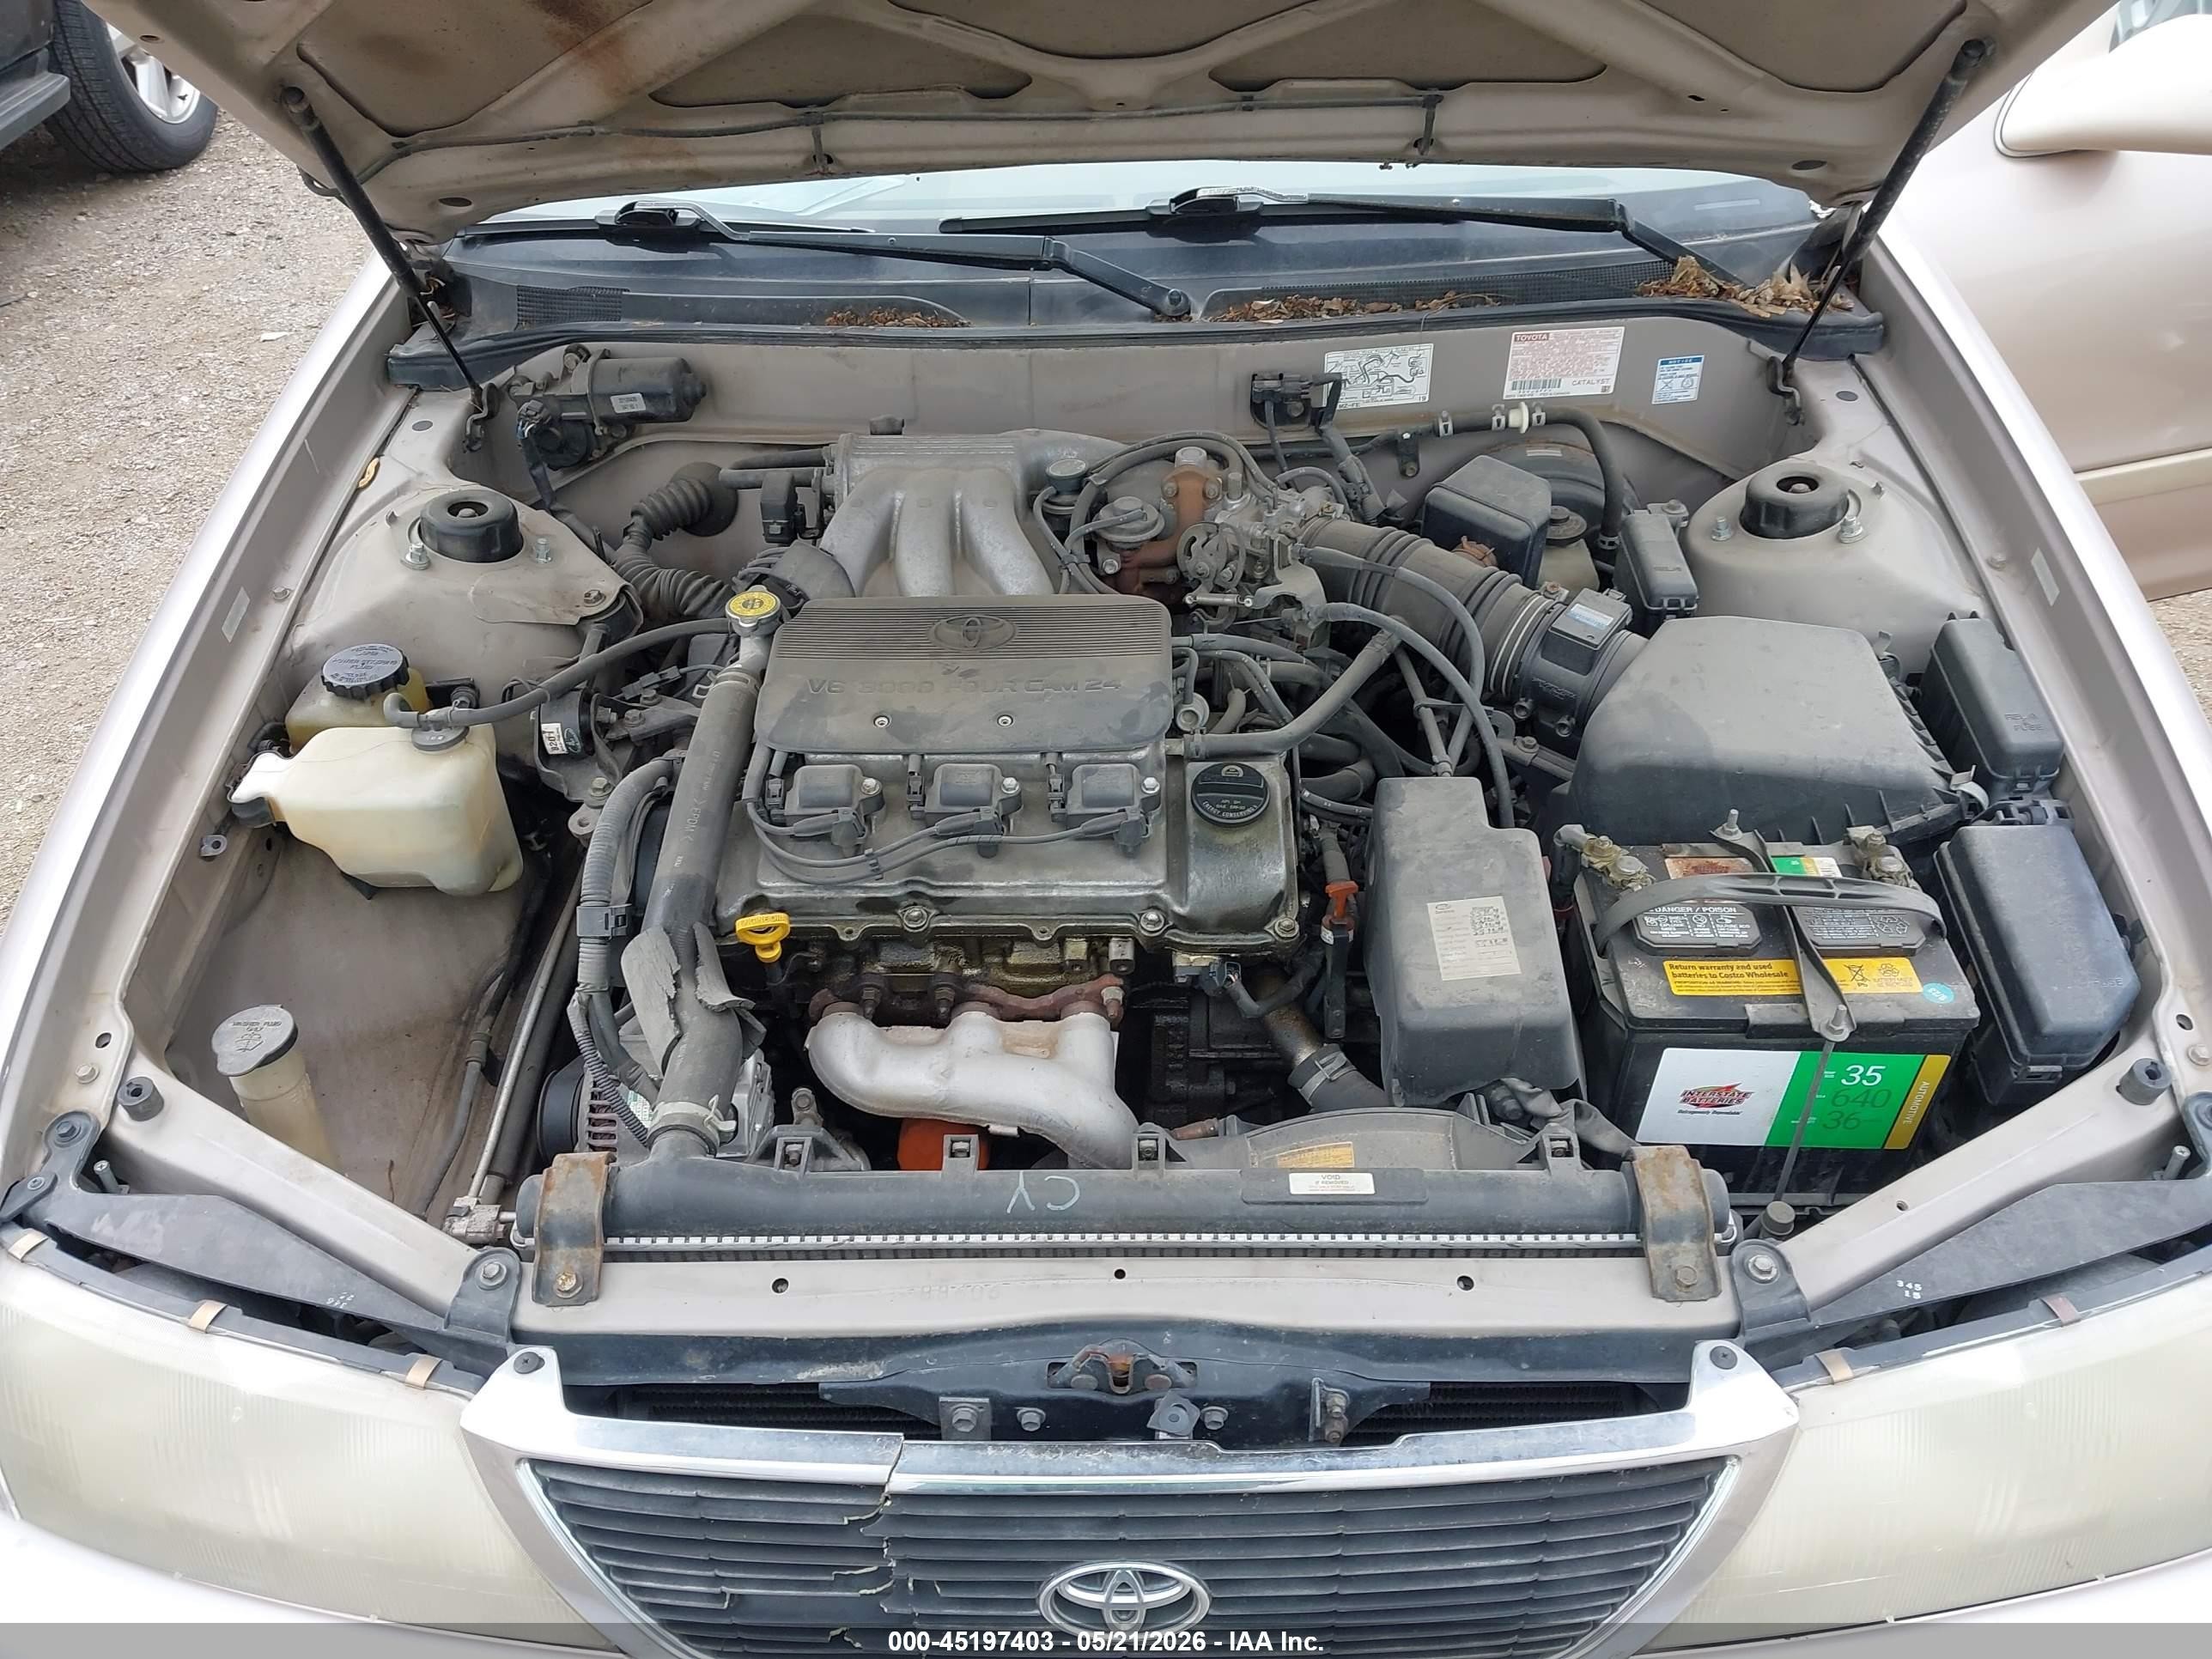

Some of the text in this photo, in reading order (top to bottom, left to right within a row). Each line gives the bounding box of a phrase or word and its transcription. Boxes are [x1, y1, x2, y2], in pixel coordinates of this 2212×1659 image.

[1571, 378, 1611, 386] CATALYST
[807, 678, 846, 694] V6
[1023, 679, 1079, 693] CAM
[1085, 679, 1122, 692] 24
[1202, 800, 1221, 815] ENERGY
[1698, 963, 1735, 972] warranty
[1840, 1064, 1887, 1086] 35
[1831, 1088, 1893, 1109] 640
[1903, 1081, 1931, 1125] AUTOMOTIVE
[1822, 1110, 1863, 1130] 36
